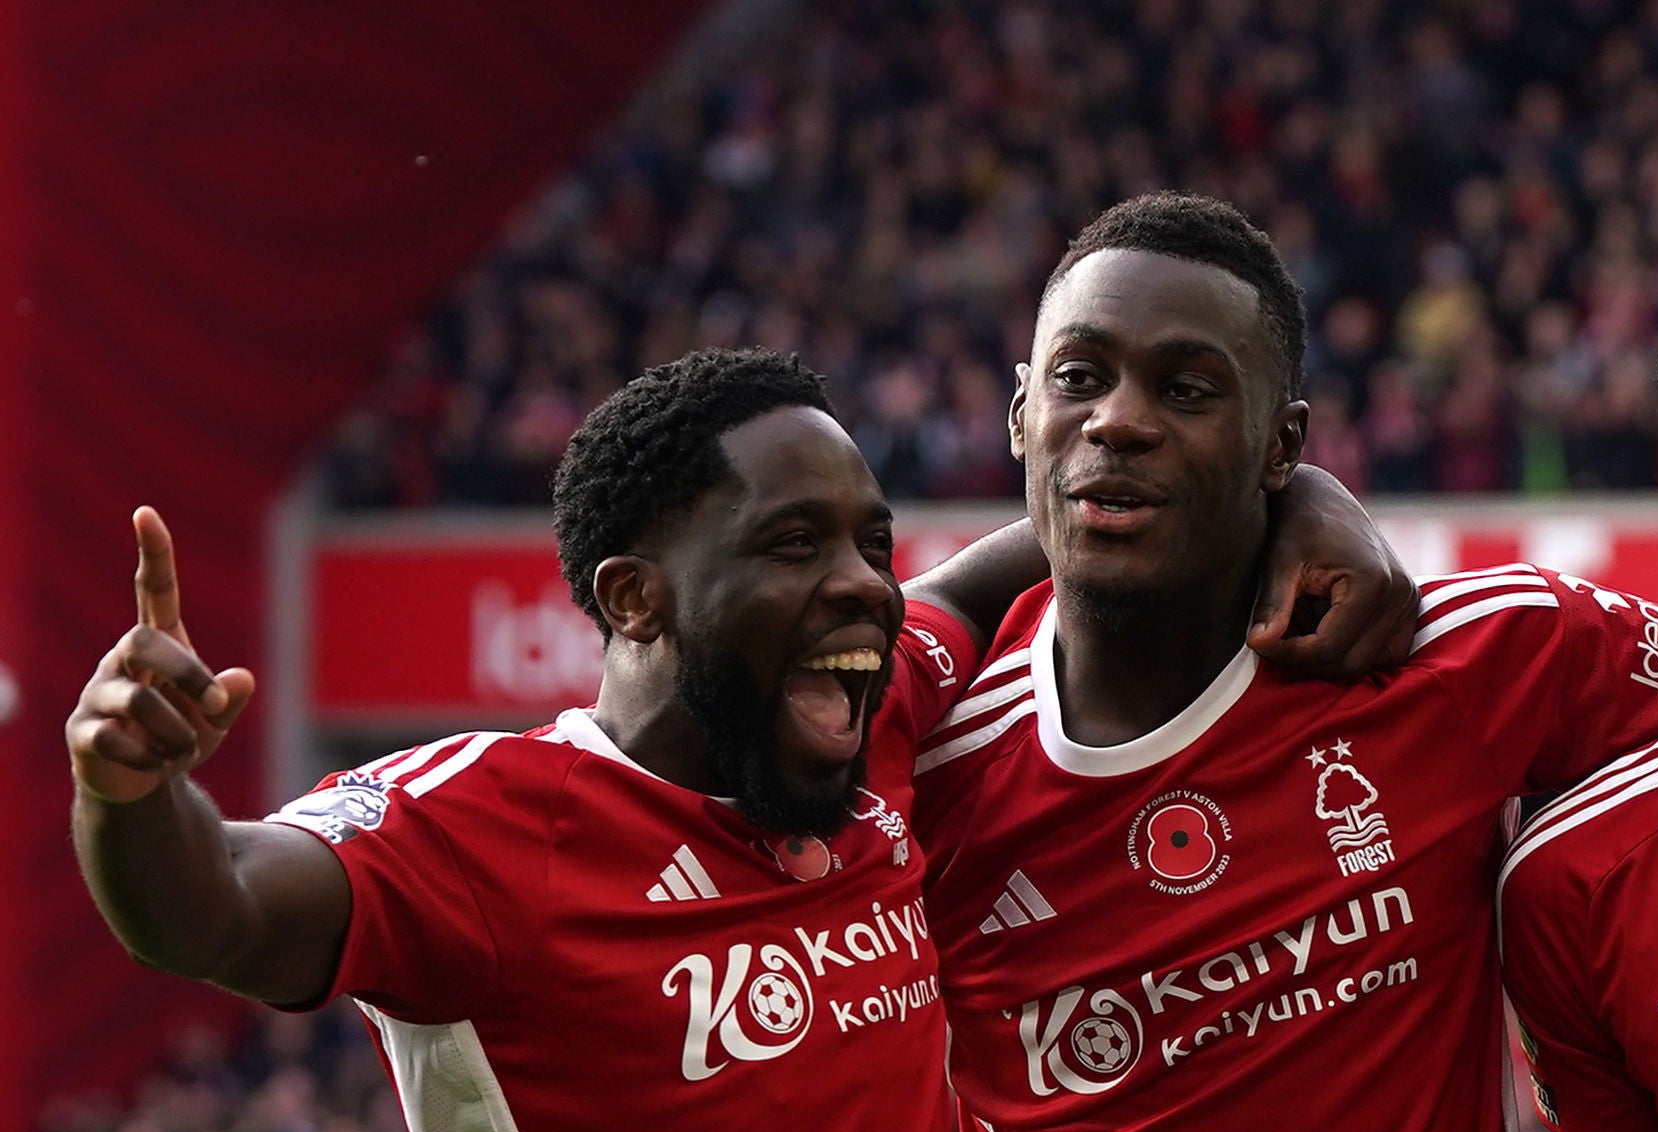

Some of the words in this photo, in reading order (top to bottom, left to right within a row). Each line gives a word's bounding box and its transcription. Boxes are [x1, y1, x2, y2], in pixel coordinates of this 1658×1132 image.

[1127, 810, 1147, 870] NOTTINGHAM
[1146, 790, 1181, 811] FOREST
[1191, 793, 1222, 816] ASTON
[1218, 814, 1233, 841] VILLA
[1167, 873, 1219, 895] NOVEMBER
